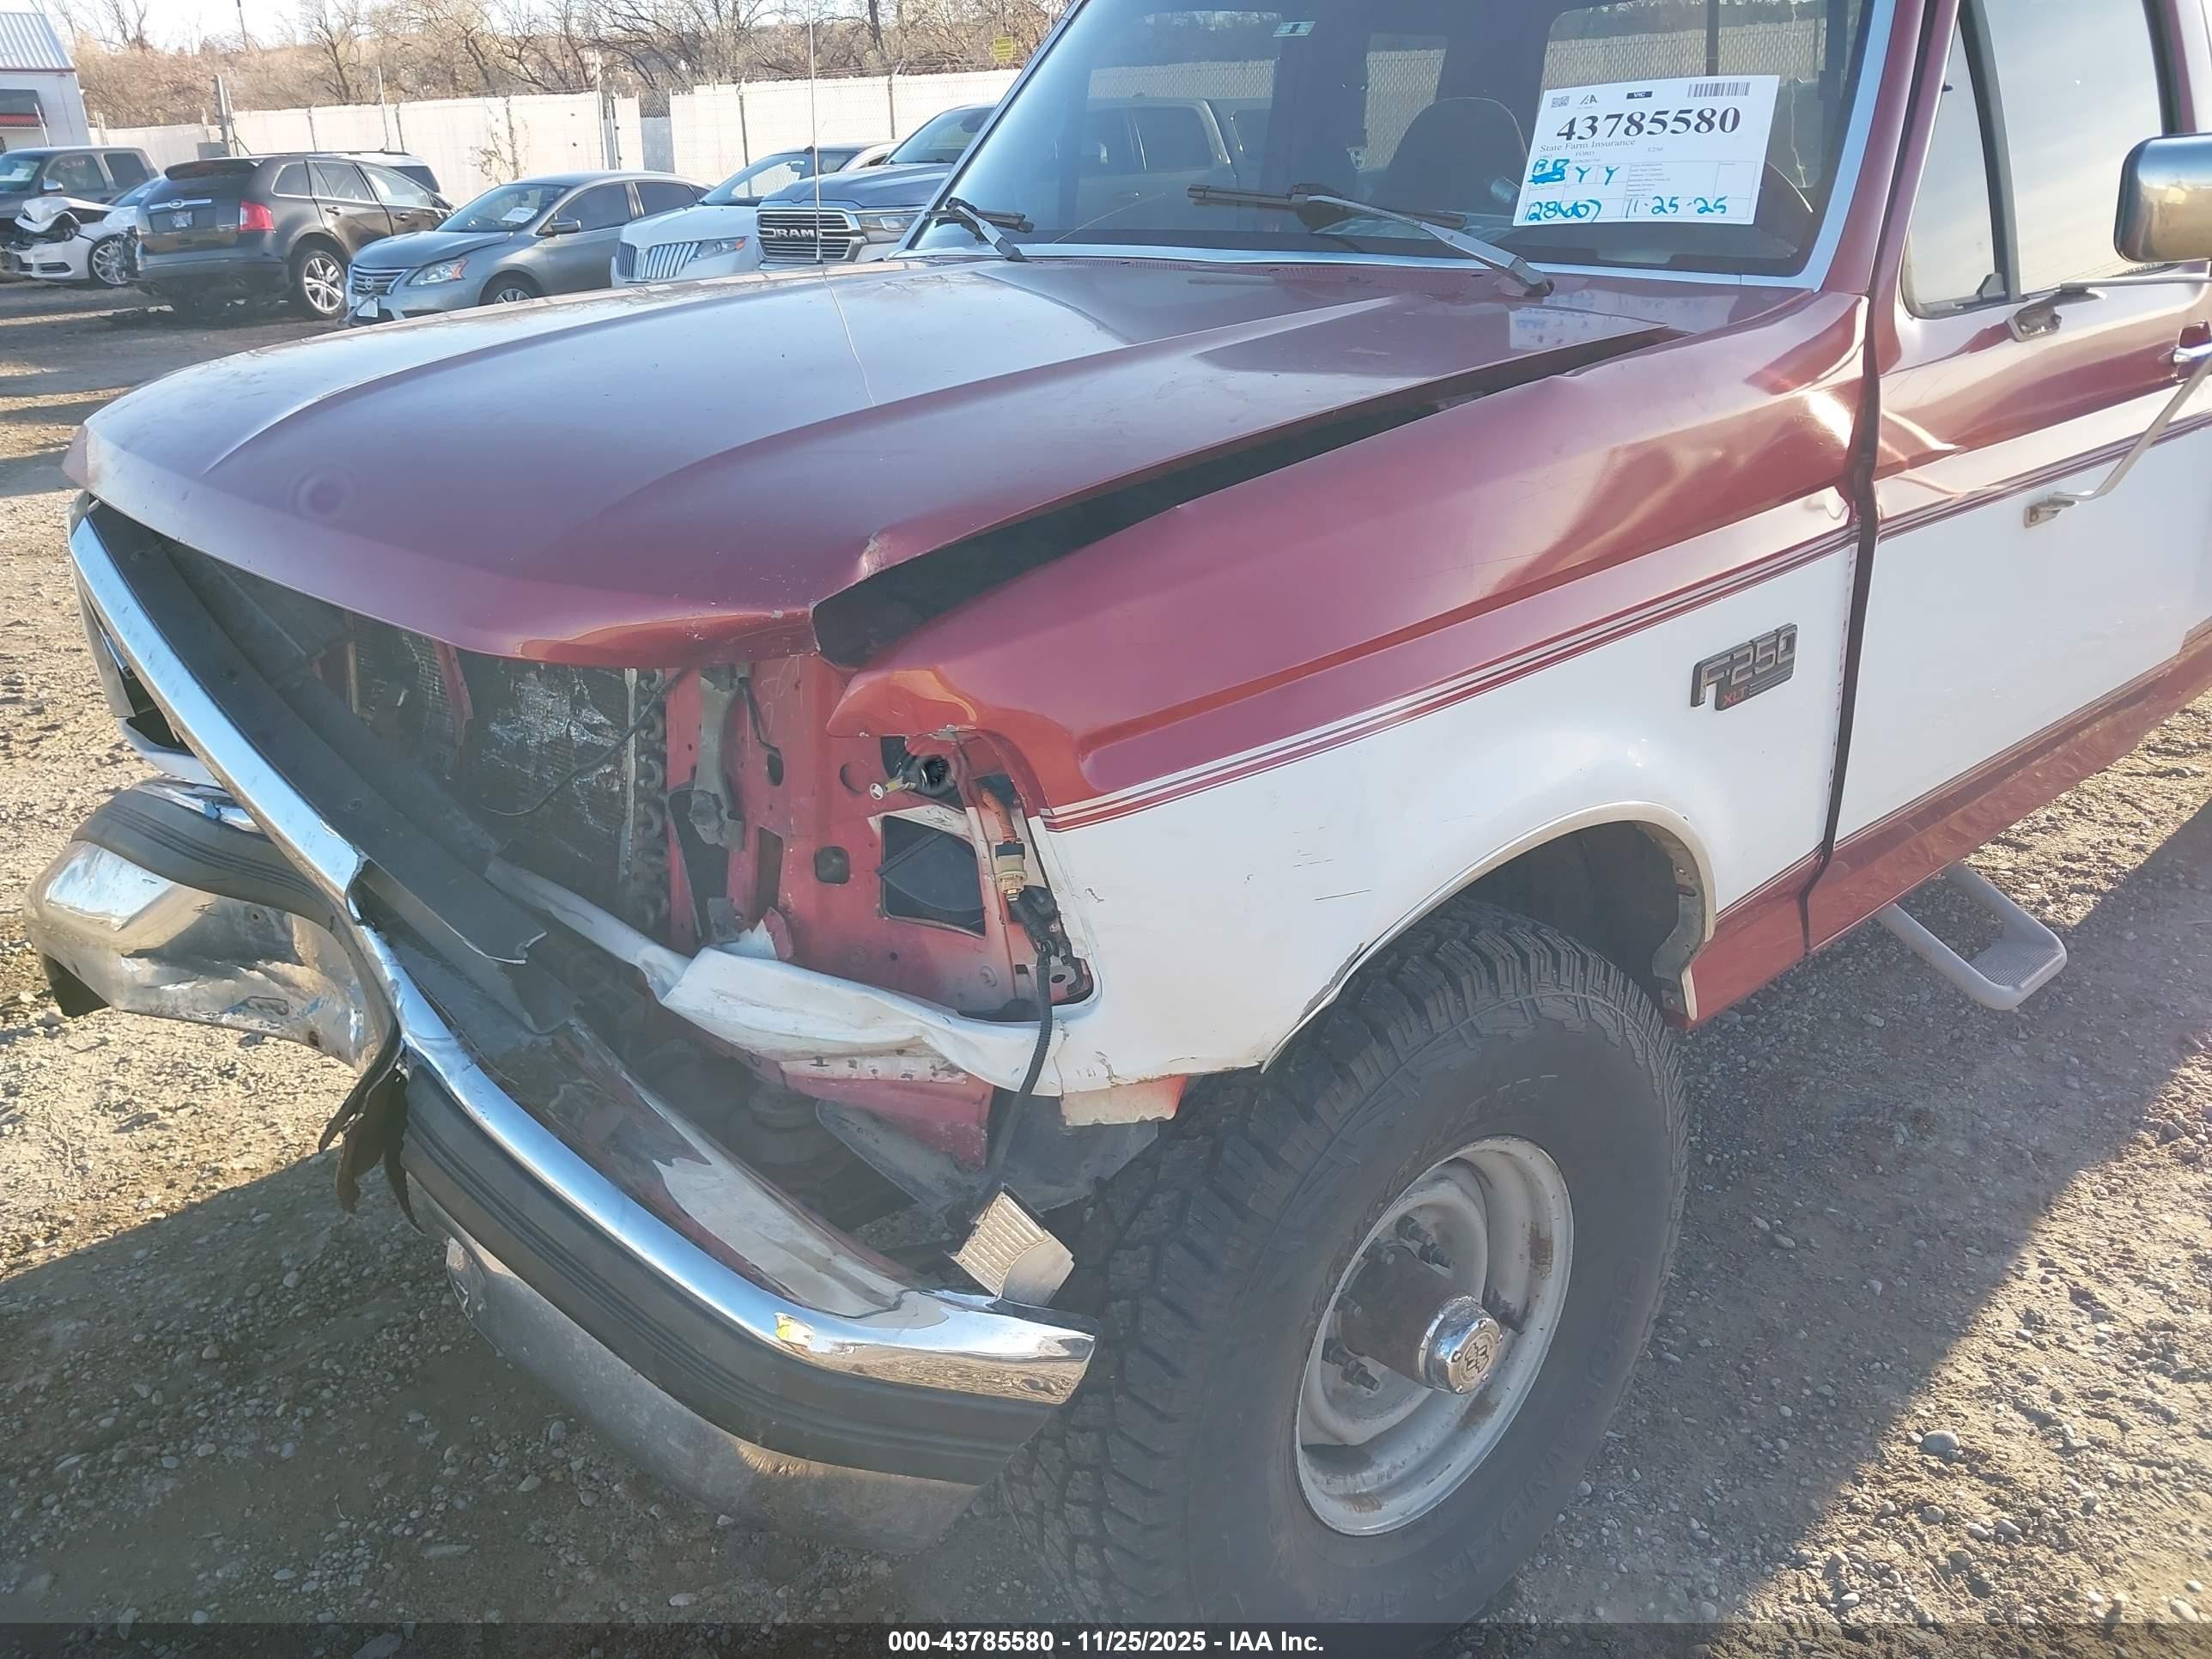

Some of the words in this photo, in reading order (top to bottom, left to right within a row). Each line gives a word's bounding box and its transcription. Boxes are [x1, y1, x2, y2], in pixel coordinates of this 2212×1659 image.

[1556, 106, 1741, 141] 43785580
[1565, 142, 1588, 150] Farm
[1591, 139, 1636, 149] Insurance
[776, 228, 815, 238] RAM
[1698, 629, 1796, 704] F250
[1723, 687, 1747, 707] XLT
